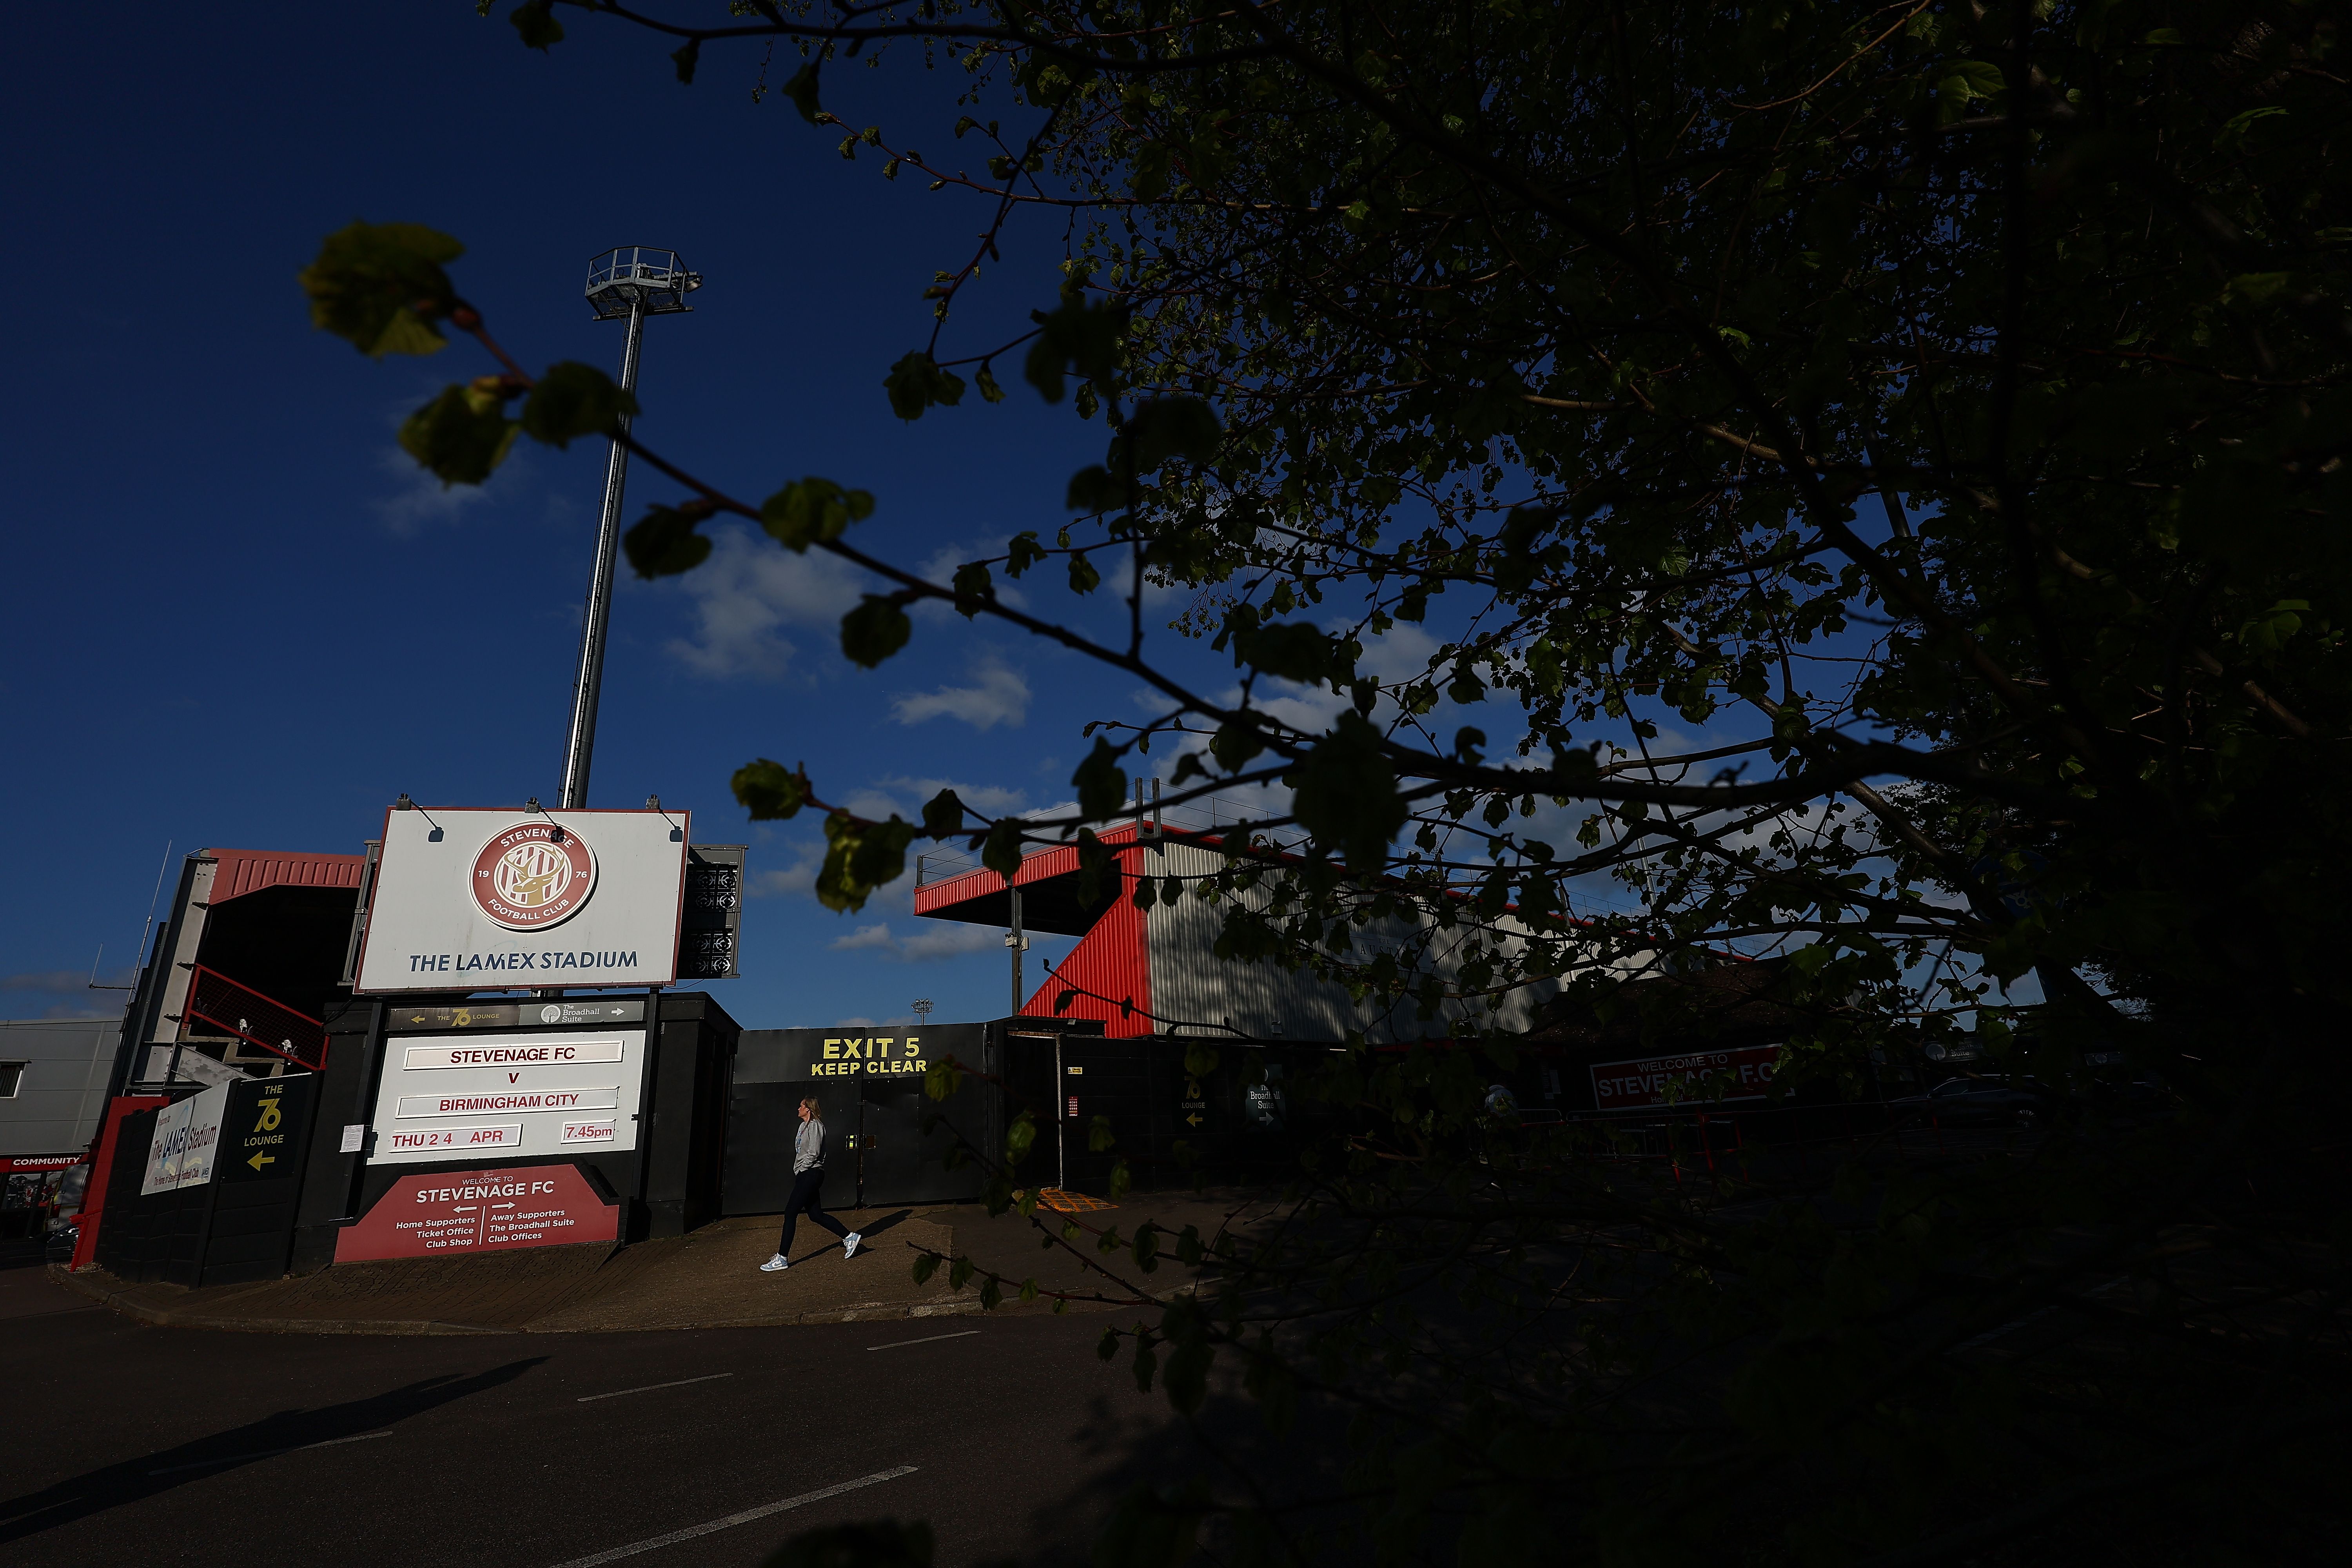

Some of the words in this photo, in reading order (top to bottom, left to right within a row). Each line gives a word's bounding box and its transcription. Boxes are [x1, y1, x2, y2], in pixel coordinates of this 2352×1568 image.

[501, 829, 574, 848] STEVENAGE
[488, 898, 540, 920] FOOTBALL
[543, 899, 569, 916] CLUB
[1360, 944, 1406, 959] AUSTI
[410, 954, 450, 972] THE
[456, 953, 536, 971] LAMEX
[540, 951, 637, 969] STADIUM
[451, 1009, 471, 1026] 76
[450, 1048, 548, 1063] STEVENAGE
[554, 1047, 575, 1060] FC
[823, 1038, 893, 1059] EXIT
[905, 1038, 919, 1057] 5
[811, 1062, 860, 1076] KEEP
[867, 1060, 926, 1073] CLEAR
[1637, 1056, 1706, 1072] WELCOME
[1708, 1054, 1728, 1065] TO
[265, 1085, 283, 1094] THE
[1598, 1067, 1727, 1097] STEVEAG
[439, 1095, 541, 1111] BIRMINGHAM
[544, 1094, 580, 1106] CITY
[1258, 1100, 1274, 1109] Suite
[253, 1098, 281, 1132] 76
[152, 1140, 162, 1161] The
[162, 1125, 189, 1158] LAMEX
[188, 1123, 217, 1151] Stadium
[244, 1134, 284, 1146] LOUNGE
[392, 1134, 424, 1147] THU
[470, 1131, 503, 1143] APR
[566, 1126, 612, 1139] 7.45pm
[13, 1157, 80, 1165] COMMUNITY
[416, 1183, 526, 1203] STEVENAGE
[531, 1181, 554, 1194] FC
[425, 1217, 475, 1228] Supporters
[517, 1210, 565, 1221] Supporters
[417, 1229, 444, 1238] Ticket
[447, 1227, 474, 1236] Office
[509, 1221, 550, 1231] Broadhall
[449, 1238, 473, 1247] Shop
[511, 1232, 542, 1241] Offices
